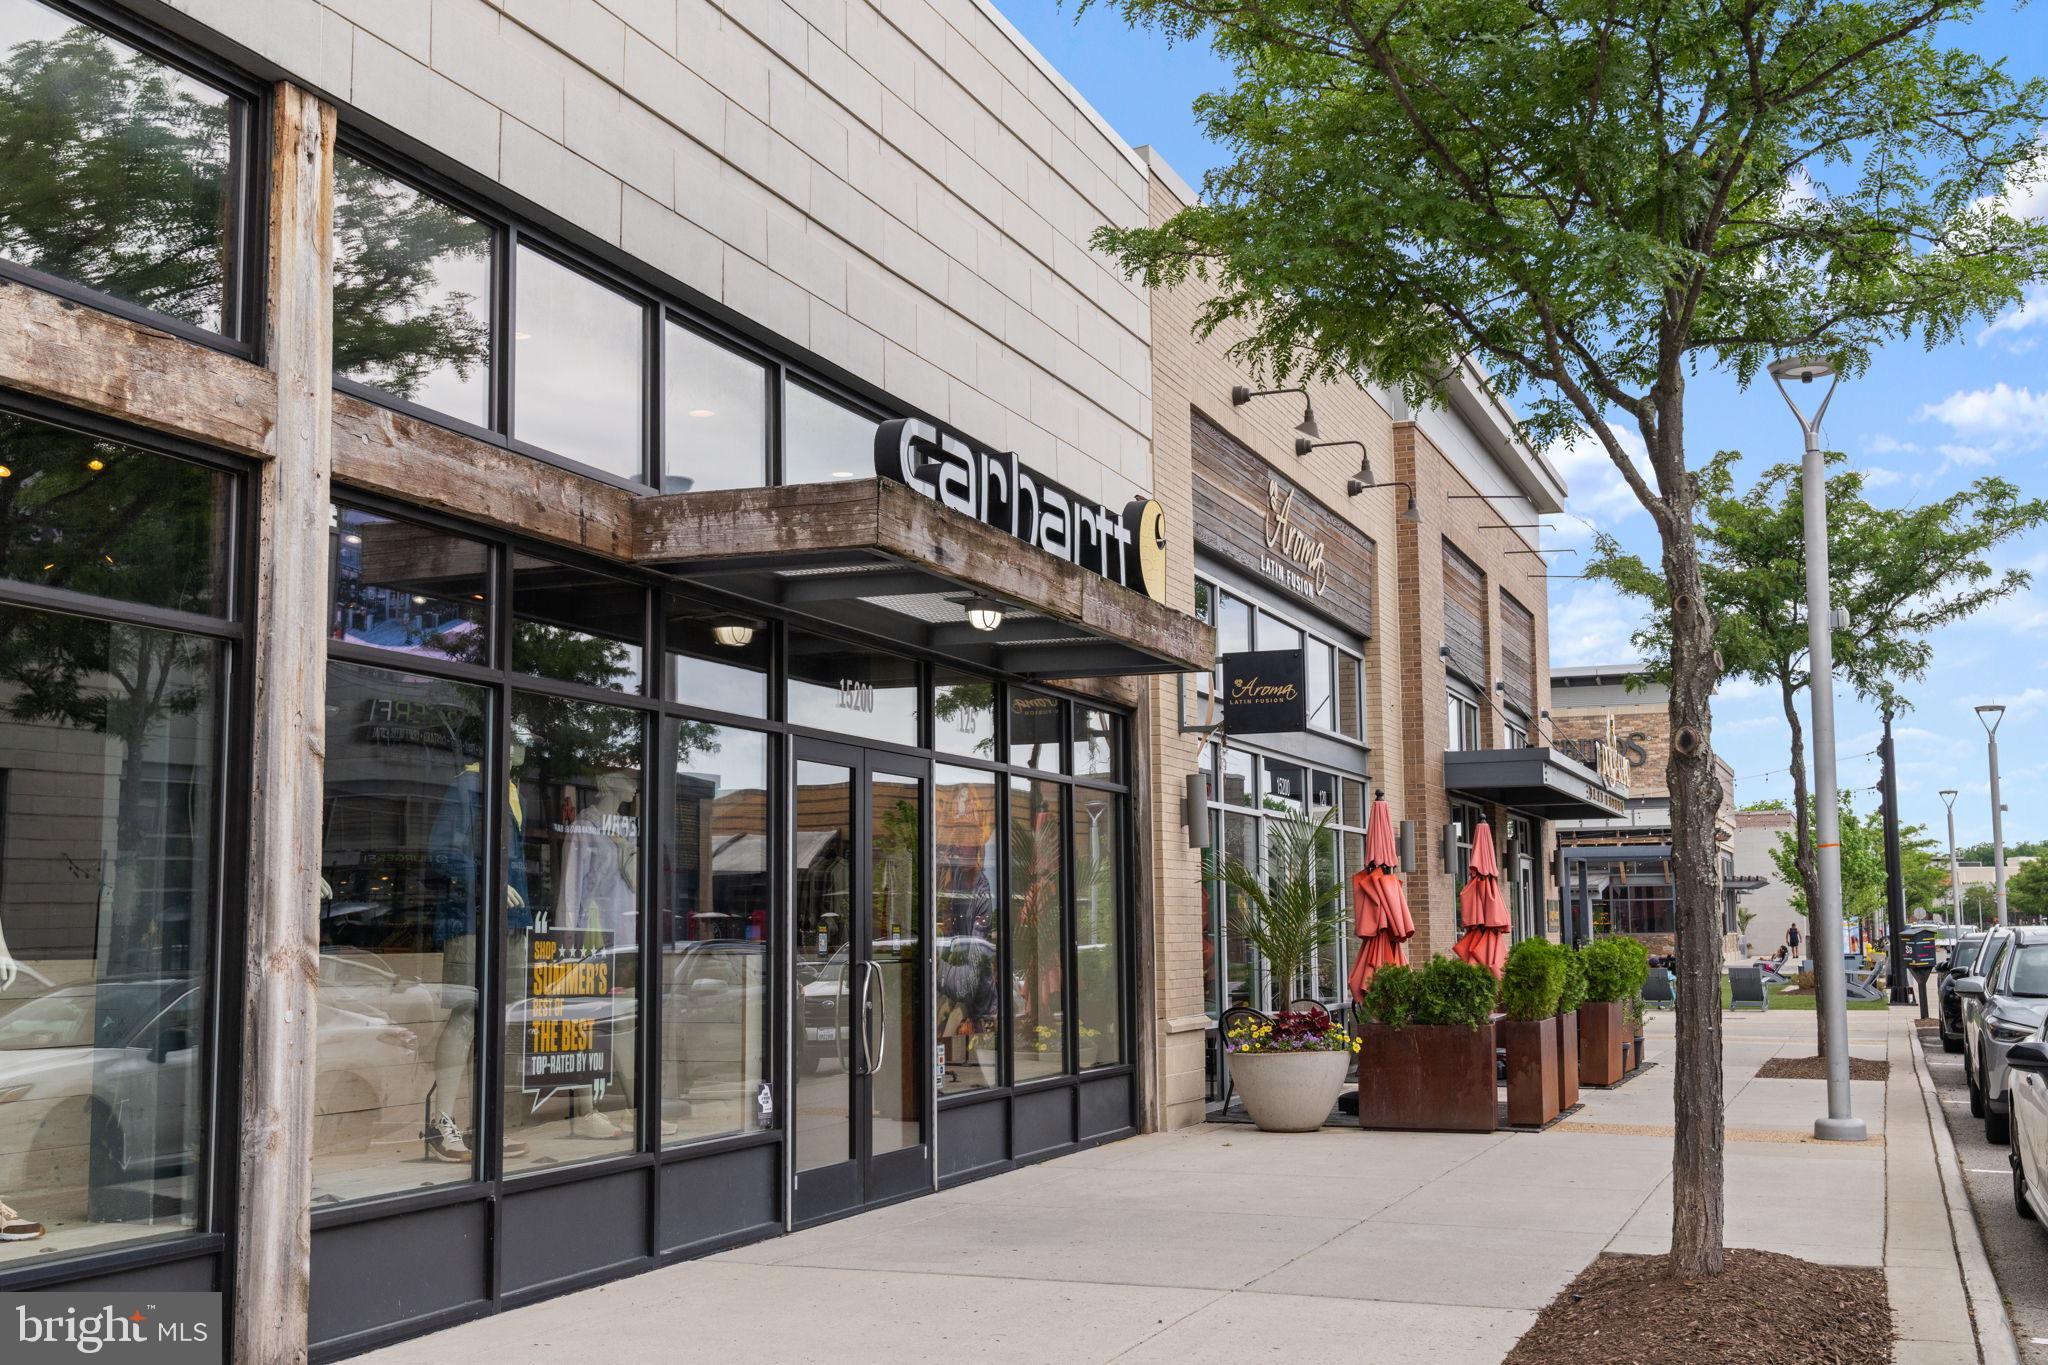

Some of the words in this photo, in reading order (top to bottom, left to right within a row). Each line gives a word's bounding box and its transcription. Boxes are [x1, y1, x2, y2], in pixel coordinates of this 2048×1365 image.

[1265, 487, 1328, 597] Aroma
[1260, 554, 1285, 582] LATIN
[1286, 570, 1314, 599] FUSION
[839, 678, 874, 714] 15200
[1231, 676, 1298, 701] Aroma
[959, 705, 976, 734] 125
[1276, 776, 1290, 797] 15200
[534, 940, 557, 960] SHOP
[533, 961, 608, 996] SUMMER'S
[532, 998, 553, 1017] BEST
[554, 998, 564, 1017] OF
[532, 1019, 559, 1054] THE
[561, 1018, 595, 1051] BEST
[531, 1054, 575, 1076] TOP-RATED
[576, 1052, 588, 1073] BY
[588, 1052, 604, 1072] YOU
